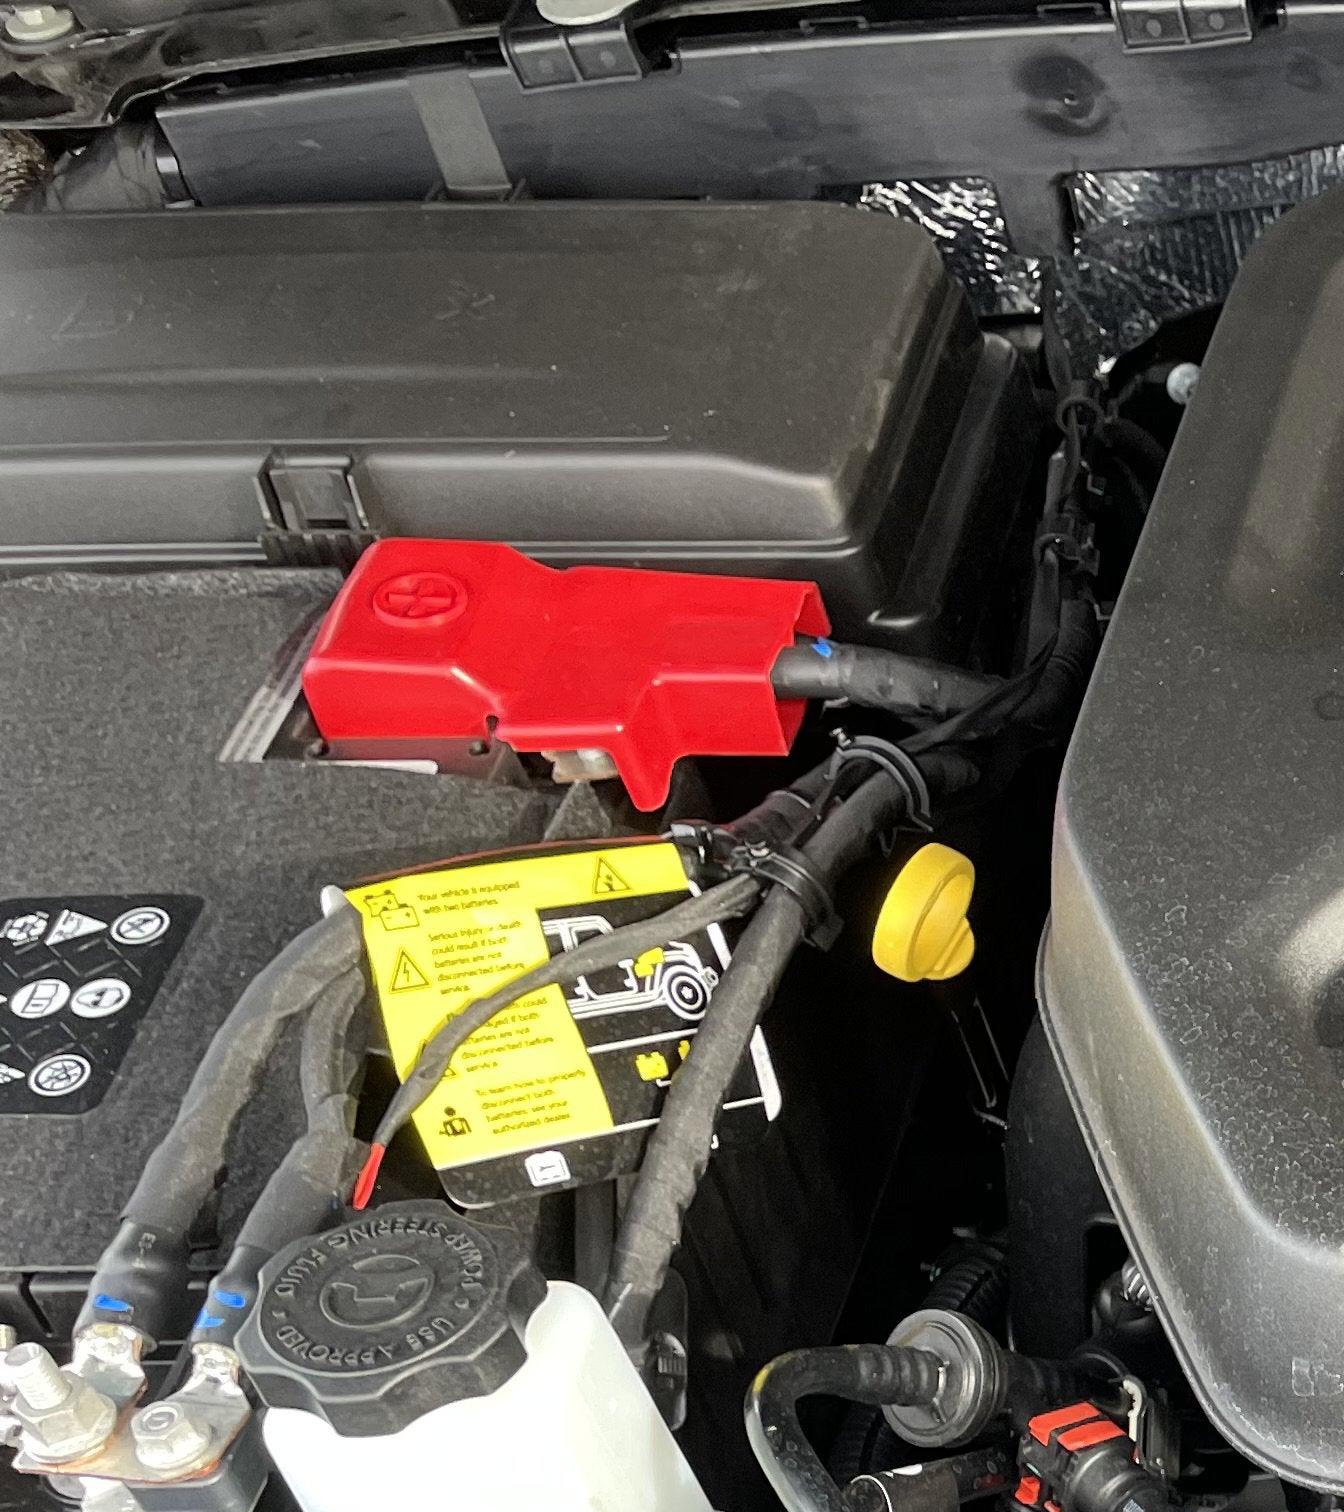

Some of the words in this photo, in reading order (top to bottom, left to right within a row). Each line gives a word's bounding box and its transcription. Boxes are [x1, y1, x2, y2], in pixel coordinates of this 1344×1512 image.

[325, 1217, 447, 1249] STEERING
[272, 1247, 328, 1298] FLUID
[443, 1232, 486, 1289] POWER
[275, 1323, 395, 1366] APPROVED
